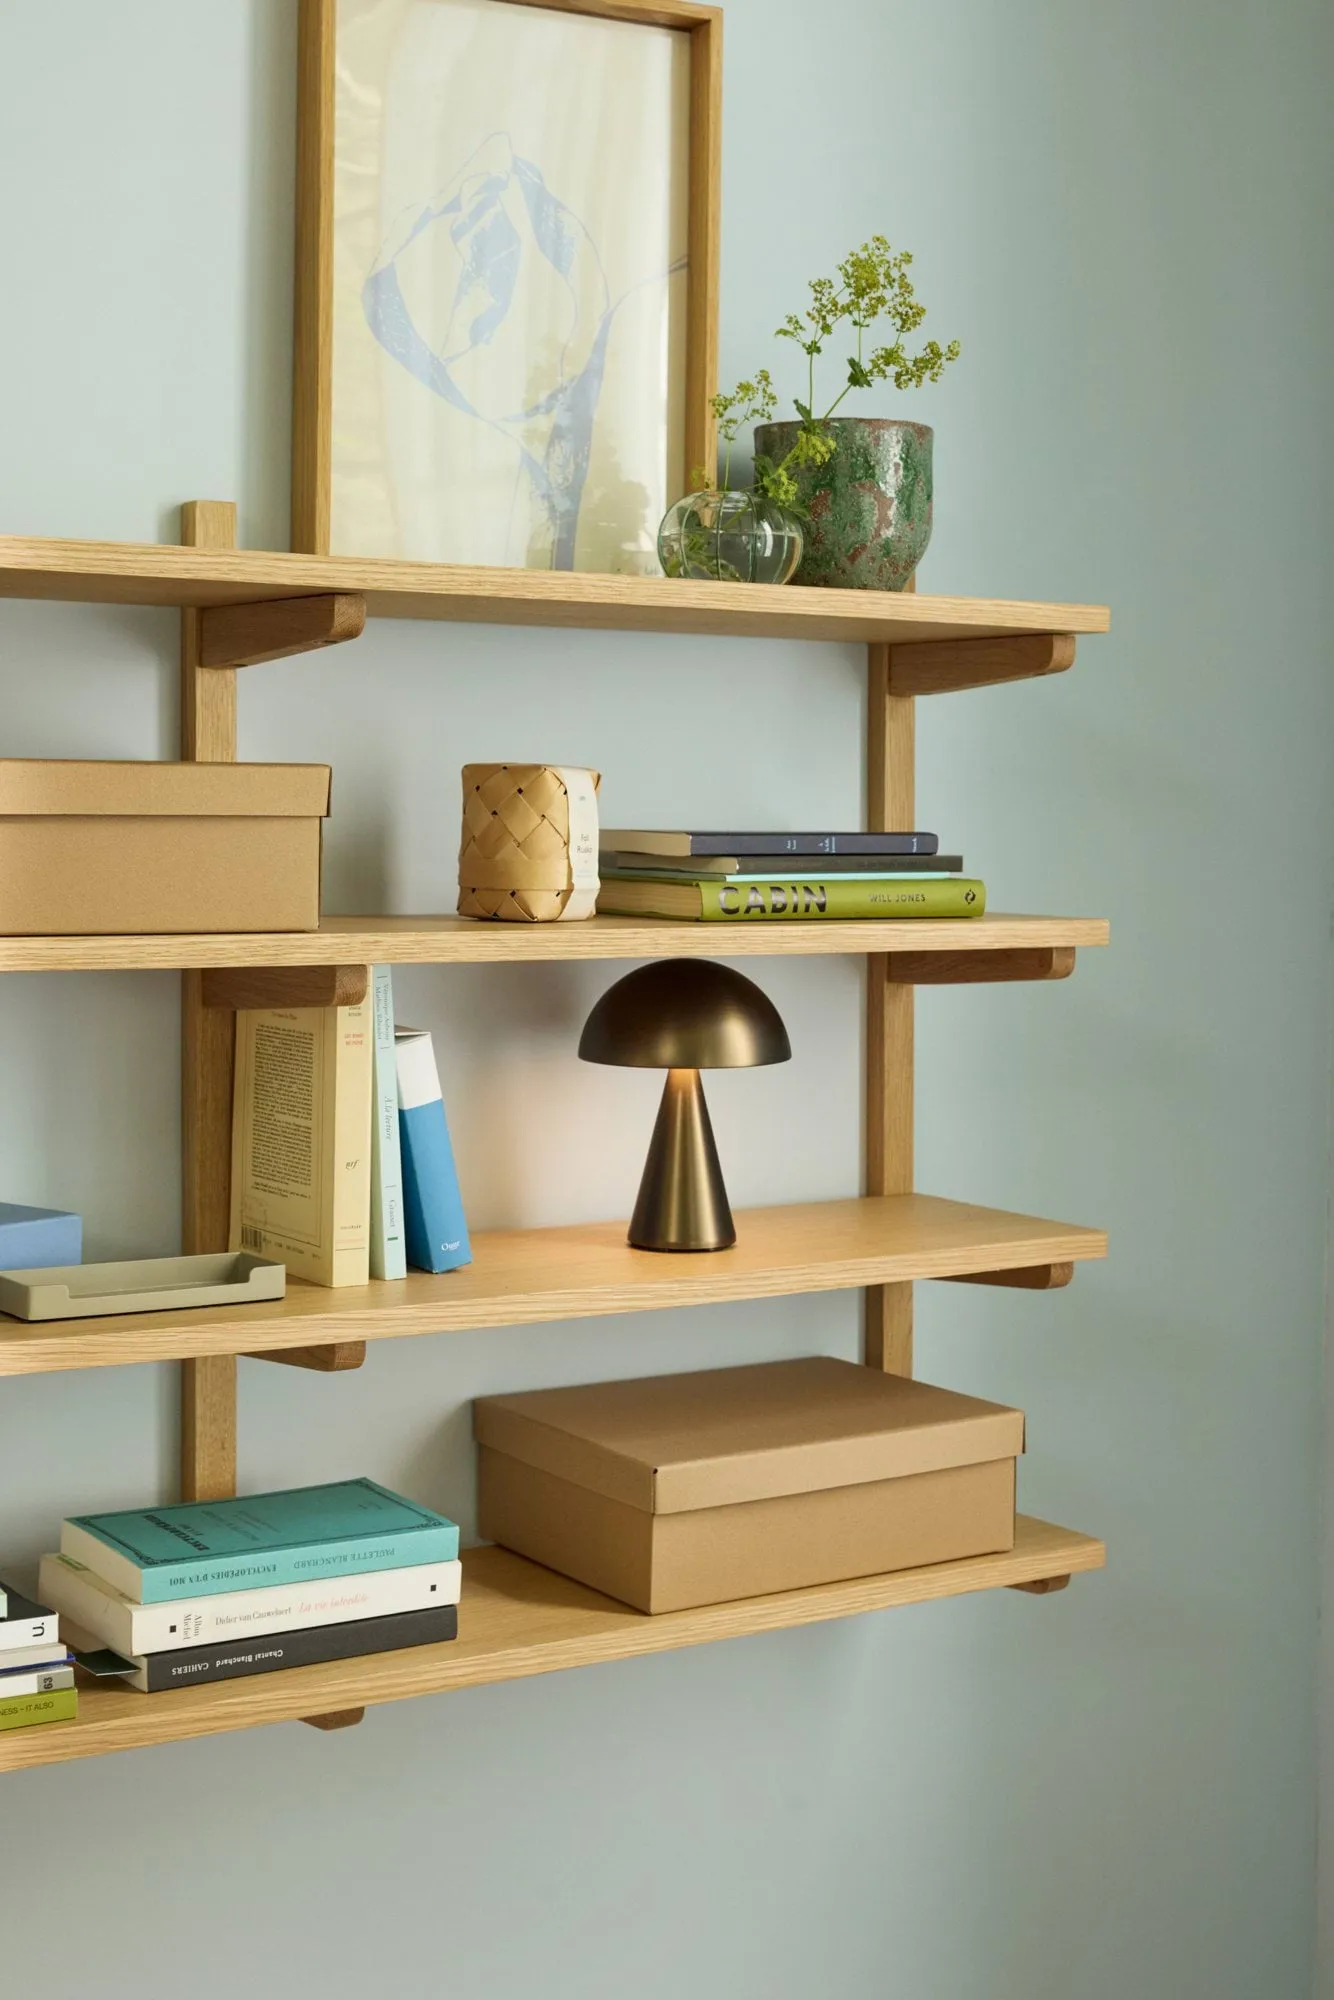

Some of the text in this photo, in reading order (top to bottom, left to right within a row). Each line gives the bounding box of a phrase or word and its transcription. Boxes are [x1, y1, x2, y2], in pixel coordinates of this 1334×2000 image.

[719, 886, 827, 915] CABIN
[868, 893, 926, 903] WILL JONES
[384, 1105, 393, 1113] la
[384, 1115, 393, 1140] lecture
[389, 1199, 397, 1227] Grasset
[293, 1547, 396, 1569] PAULETTE BLANCHARD
[211, 1564, 277, 1581] ENCYCLOPÉDIES
[169, 1576, 186, 1587] MOI
[298, 1602, 312, 1613] La
[315, 1601, 328, 1610] vie
[215, 1607, 292, 1626] Didier van Cauwelaert
[183, 1613, 192, 1640] Michel
[194, 1615, 202, 1636] Albin
[216, 1649, 284, 1667] Chantal Blanchard
[171, 1662, 209, 1675] CAHIERS
[43, 1677, 53, 1689] 63
[34, 1702, 54, 1711] ALSO
